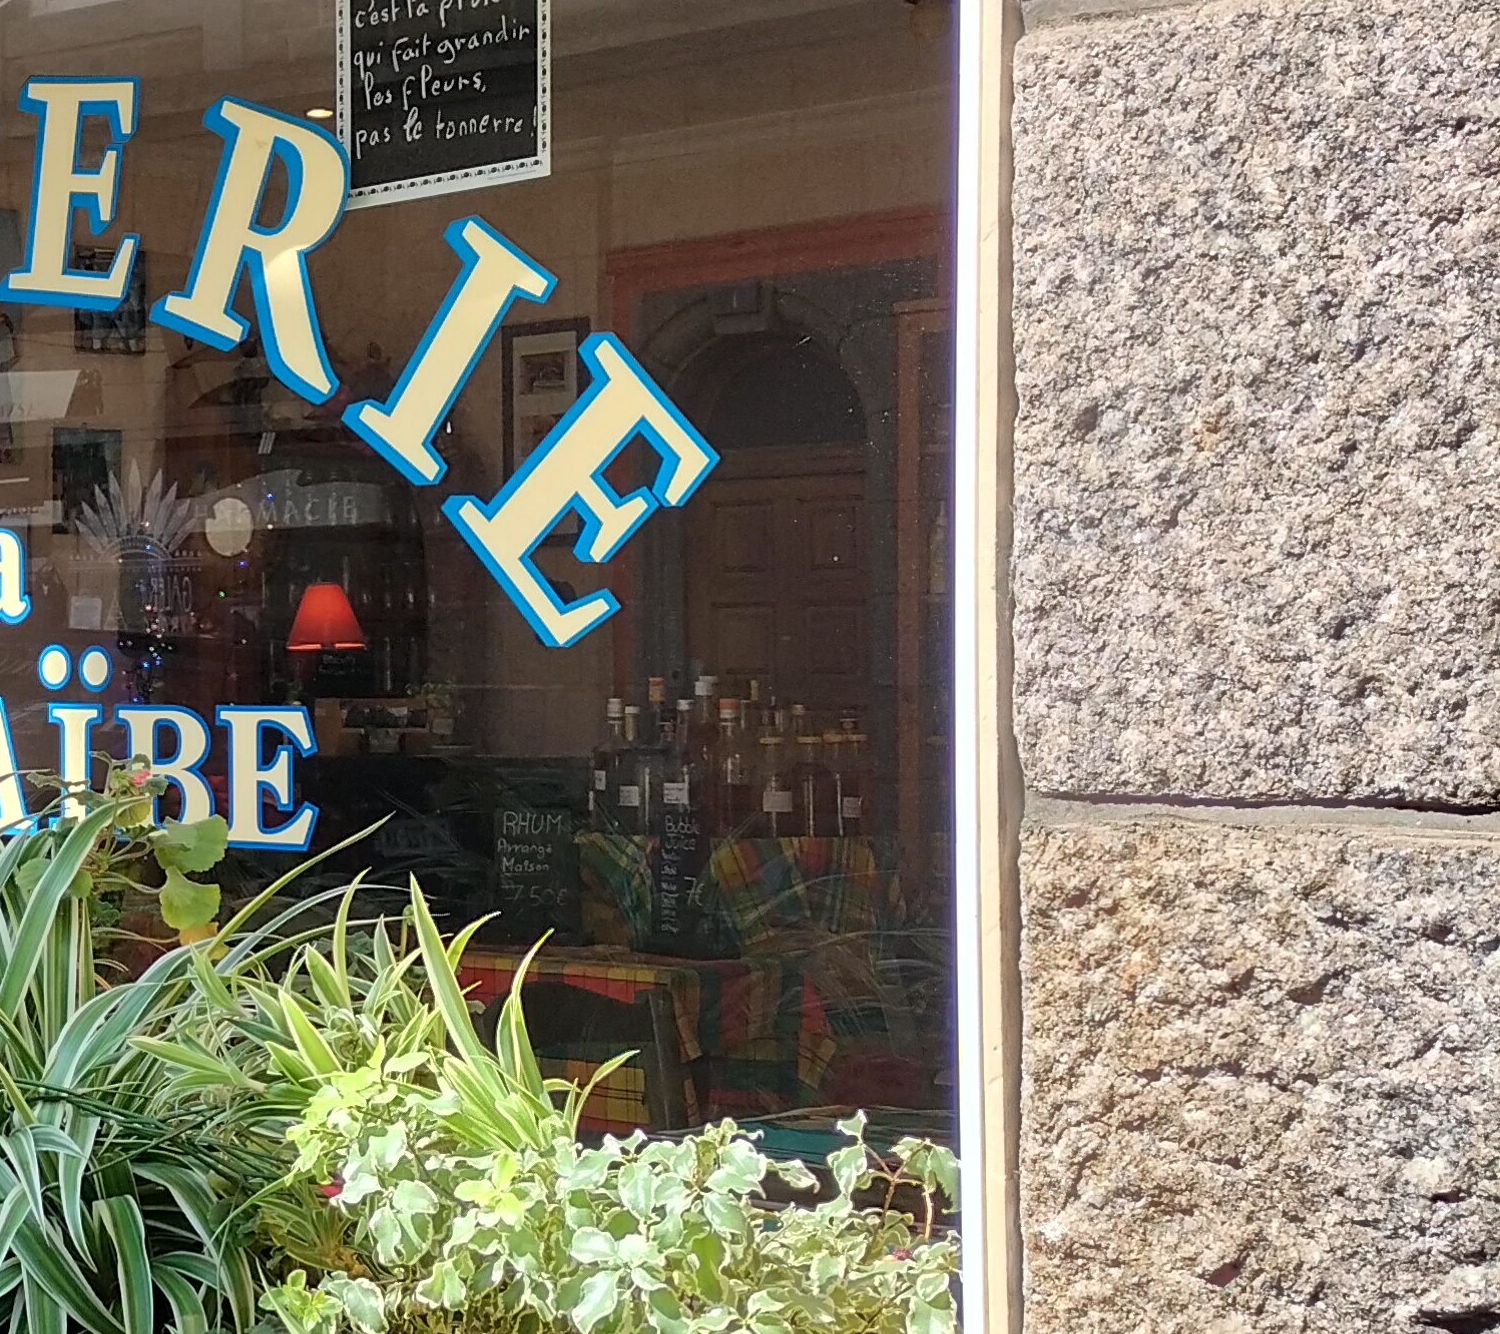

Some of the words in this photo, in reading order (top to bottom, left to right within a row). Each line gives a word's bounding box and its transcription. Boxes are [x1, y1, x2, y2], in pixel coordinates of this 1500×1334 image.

[354, 41, 384, 81] qui
[392, 32, 431, 72] fait
[437, 14, 530, 64] grandir
[364, 71, 392, 110] les
[356, 127, 390, 159] pas
[403, 107, 422, 142] le
[503, 811, 562, 836] RHUM
[665, 815, 699, 834] Bubble
[666, 833, 695, 851] Juice
[502, 857, 549, 873] Maison
[684, 877, 704, 907] 7€
